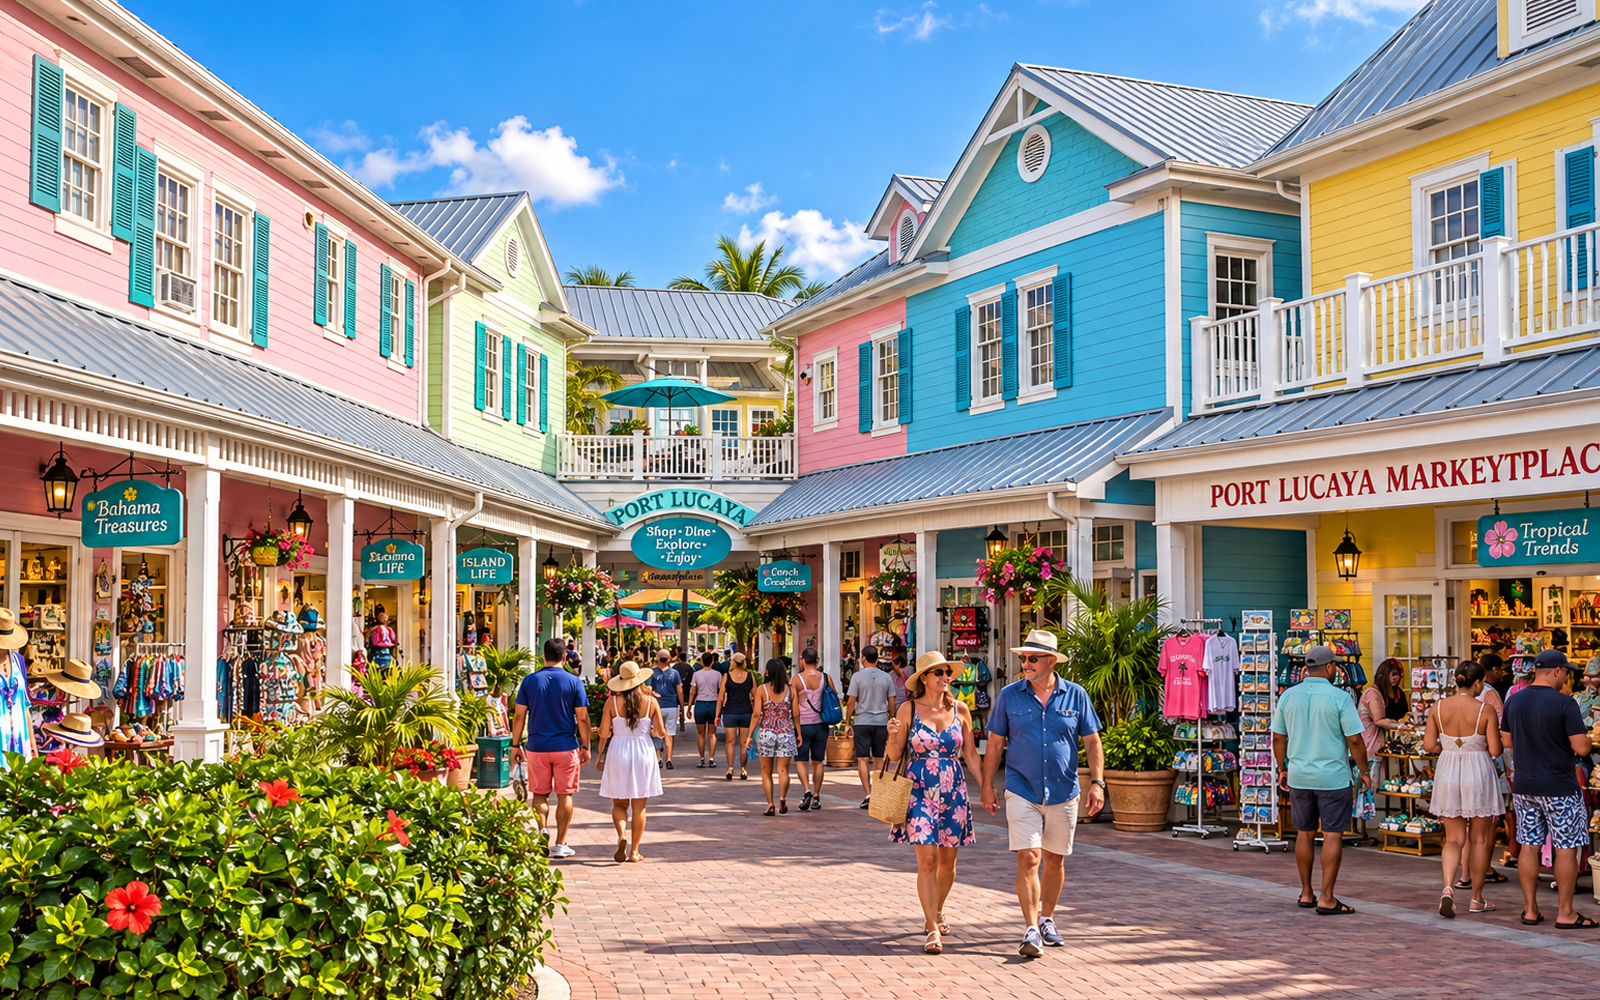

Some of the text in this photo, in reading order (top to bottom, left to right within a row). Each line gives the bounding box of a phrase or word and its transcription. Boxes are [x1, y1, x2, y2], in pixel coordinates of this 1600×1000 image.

[1210, 479, 1270, 508] PORT
[1278, 469, 1376, 503] LUCAYA
[97, 499, 161, 517] Bahama
[612, 491, 746, 525] PORT LUCAYA
[94, 518, 168, 535] Treasures
[646, 525, 677, 539] Shop
[1520, 518, 1589, 543] Tropical
[1522, 537, 1579, 557] Trends
[462, 556, 506, 568] ISLAND
[666, 551, 697, 566] Enjoy
[378, 562, 405, 574] LIFE
[470, 568, 497, 579] LIFE
